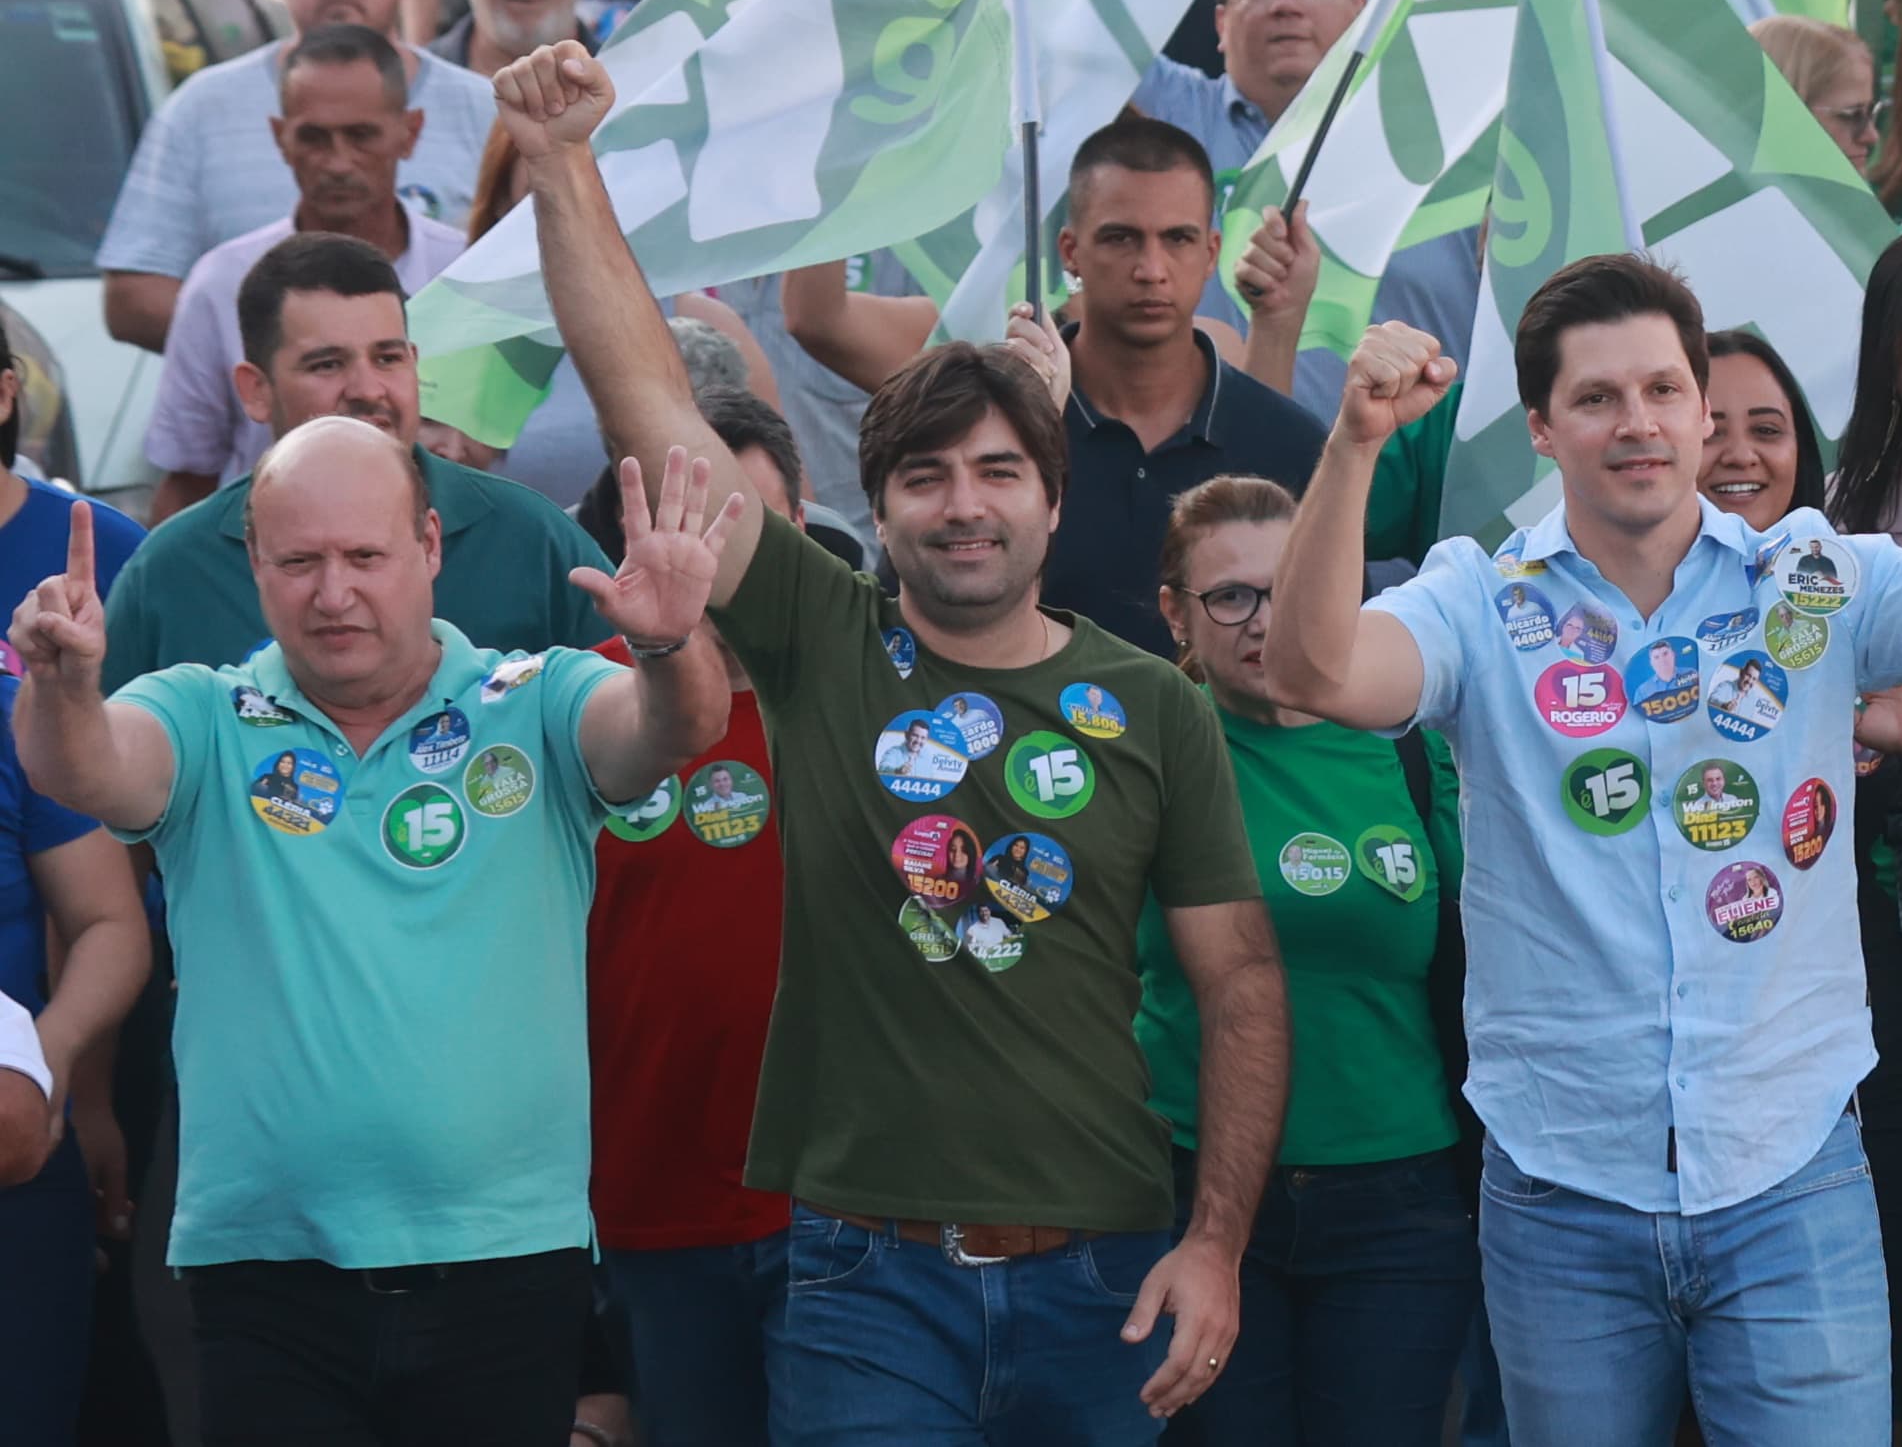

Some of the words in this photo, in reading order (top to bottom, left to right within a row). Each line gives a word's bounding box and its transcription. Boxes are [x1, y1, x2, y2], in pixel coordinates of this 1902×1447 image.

[1788, 572, 1818, 585] ERIC
[1800, 585, 1845, 594] MENEZES
[1792, 593, 1841, 608] 15222
[1505, 614, 1549, 633] Ricardo
[1792, 624, 1821, 644] FALA
[1513, 630, 1553, 647] 44000
[1779, 632, 1823, 661] GROSSA
[1789, 645, 1822, 666] 15615
[1562, 672, 1606, 708] 15
[1714, 713, 1756, 739] 44444
[493, 771, 526, 790] FALA
[1024, 769, 1037, 793] é
[1029, 749, 1085, 802] 15
[479, 780, 529, 808] GROSSA
[695, 785, 707, 797] 15
[890, 779, 941, 797] 44444
[1585, 762, 1641, 817] 15
[1687, 783, 1698, 795] 15
[488, 793, 526, 814] 15615
[1580, 788, 1592, 810] é
[404, 801, 456, 852] 15
[701, 814, 761, 842] 11123
[1684, 811, 1719, 825] Dias
[1688, 819, 1747, 843] 11123
[1793, 835, 1824, 864] 15200
[903, 865, 926, 875] SILVA
[1375, 843, 1417, 885] 15
[906, 873, 960, 901] 15200
[1717, 896, 1777, 924] ELIENE
[1729, 918, 1774, 939] 15640
